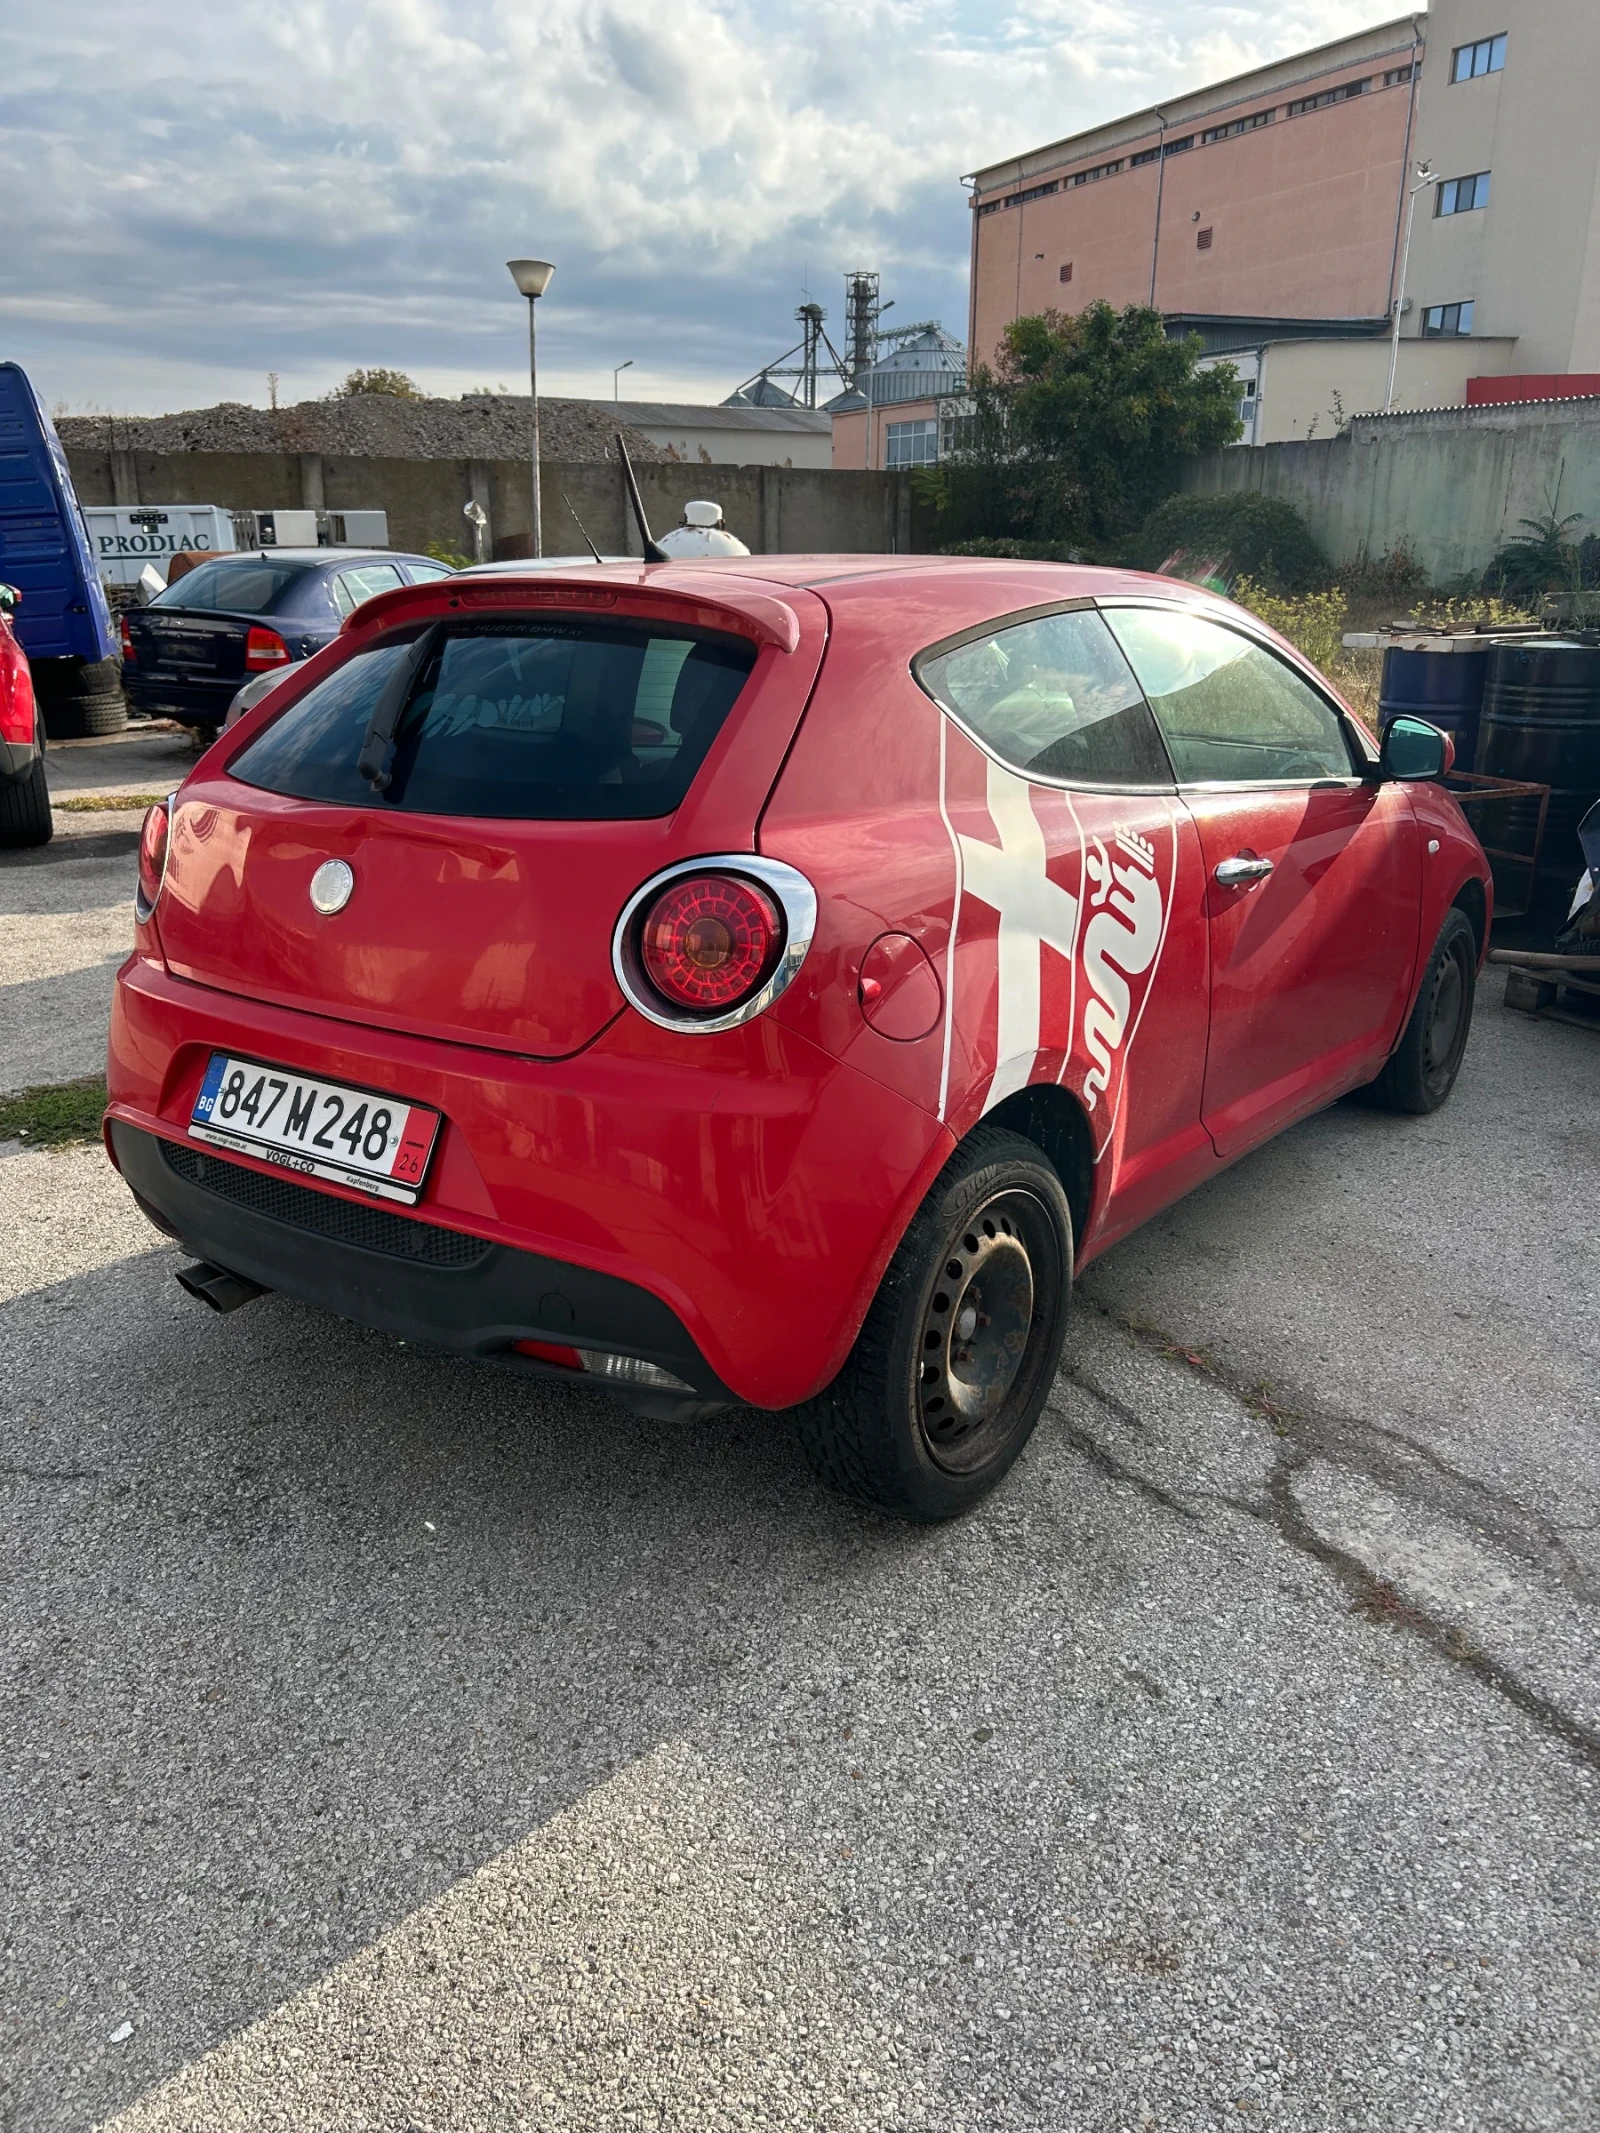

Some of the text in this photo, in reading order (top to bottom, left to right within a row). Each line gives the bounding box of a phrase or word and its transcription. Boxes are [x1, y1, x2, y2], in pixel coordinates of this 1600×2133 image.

[98, 534, 210, 553] PRODIAC
[197, 1095, 215, 1112] BG
[265, 1150, 315, 1173] VOGL+CO
[398, 1153, 418, 1174] 26
[346, 1175, 380, 1192] Kapfenberg
